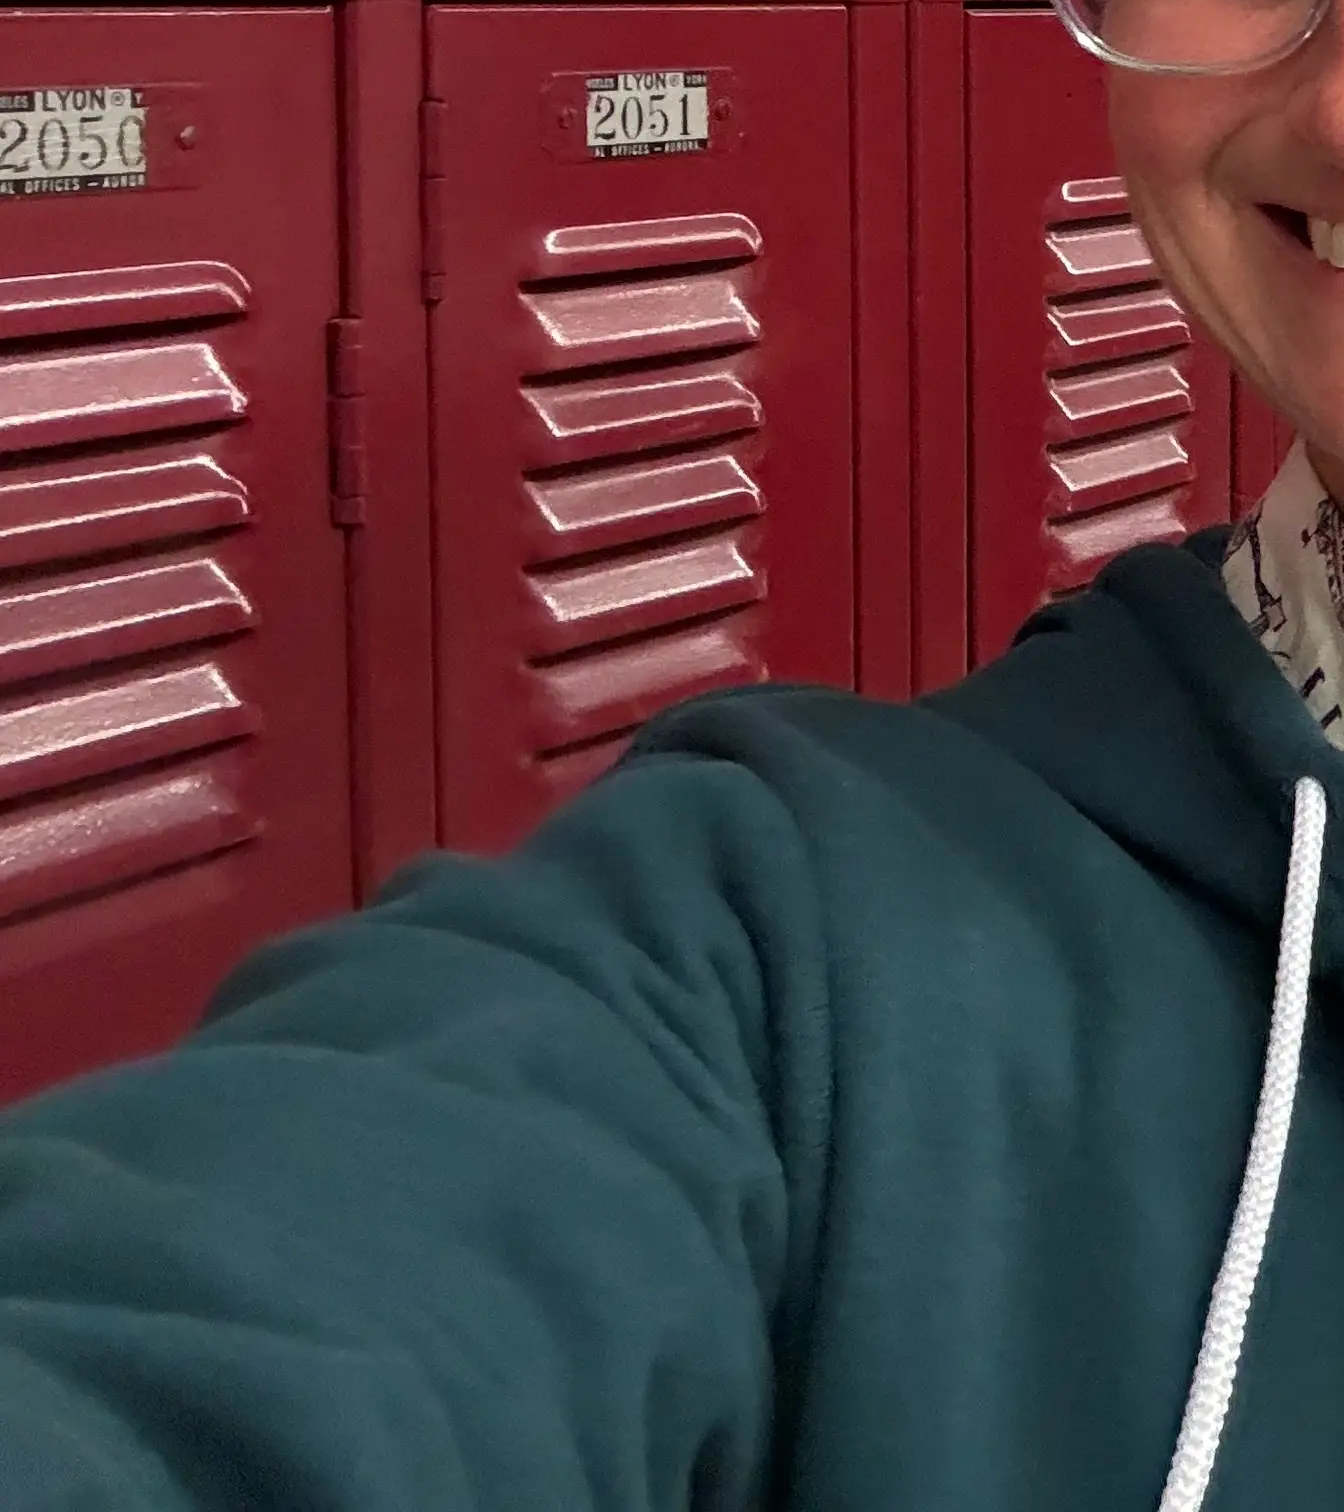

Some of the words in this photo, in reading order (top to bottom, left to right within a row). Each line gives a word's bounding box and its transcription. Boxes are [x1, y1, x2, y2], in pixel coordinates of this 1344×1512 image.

[623, 73, 667, 91] LYON
[42, 89, 106, 111] LYON
[594, 94, 690, 140] 2051
[0, 116, 144, 174] 2050
[24, 177, 80, 194] OFFICES
